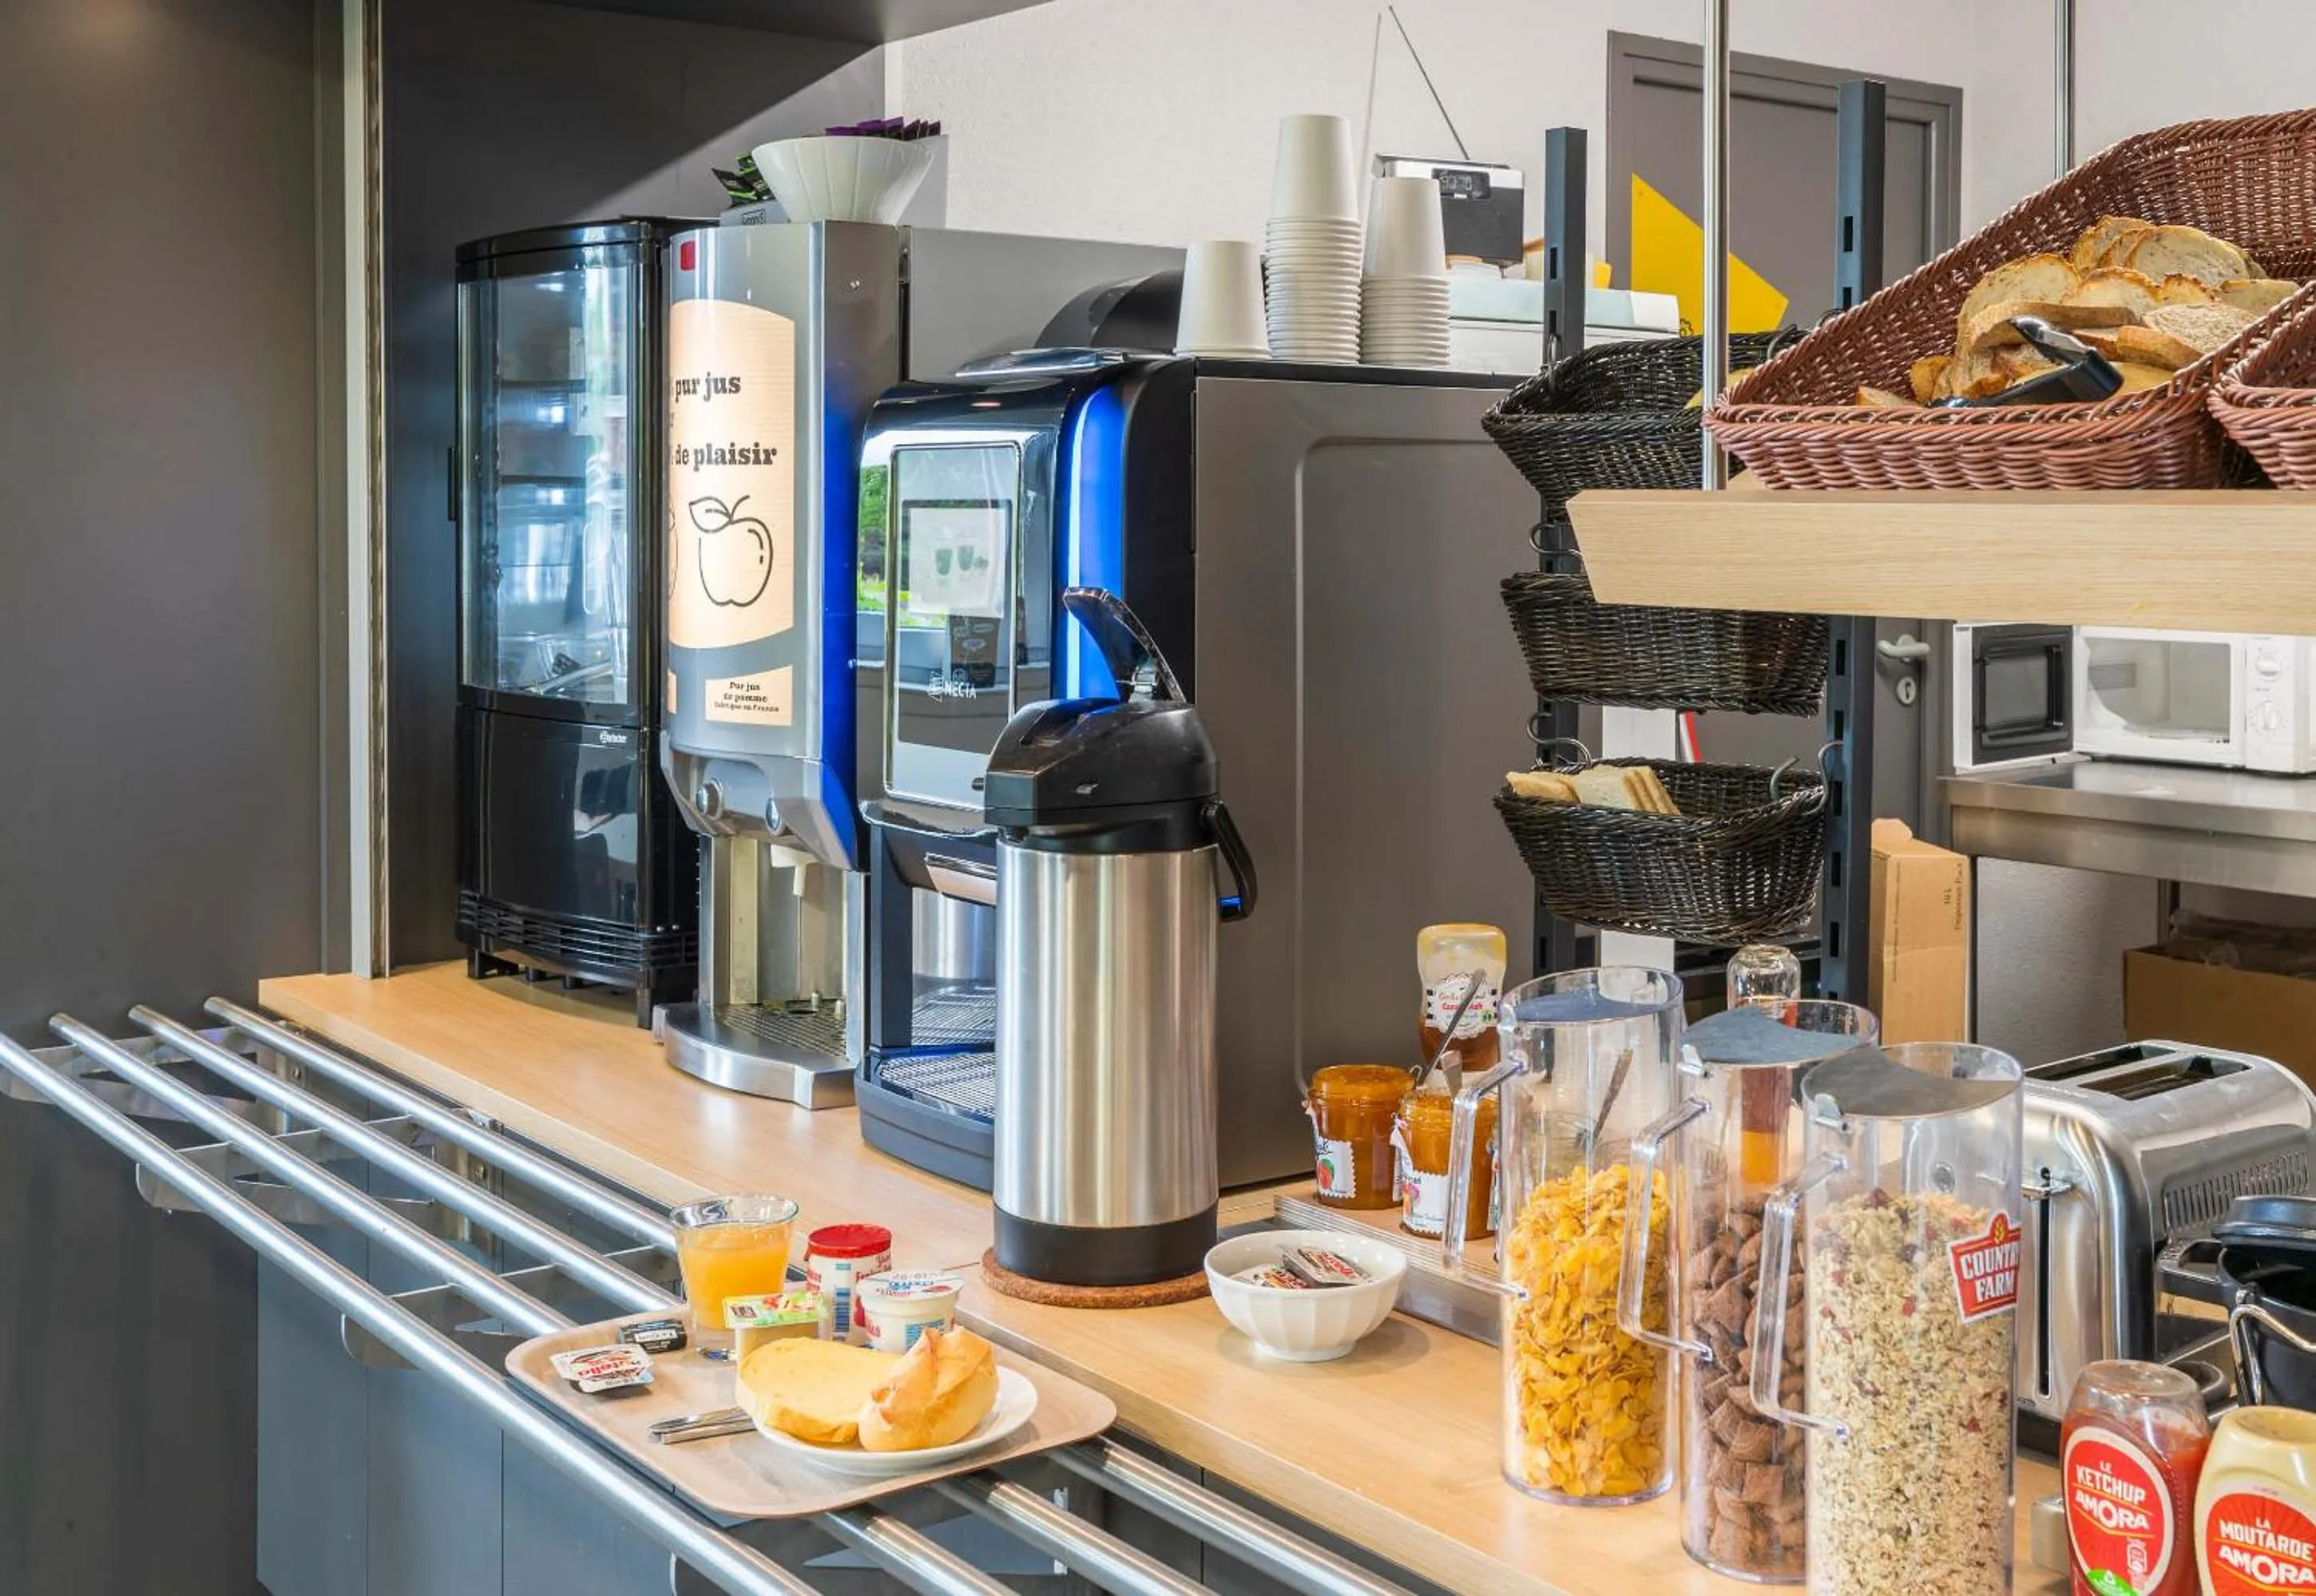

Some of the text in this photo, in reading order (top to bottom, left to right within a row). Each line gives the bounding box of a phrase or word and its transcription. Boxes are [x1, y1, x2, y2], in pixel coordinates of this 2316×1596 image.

[676, 371, 741, 403] pur jus
[676, 442, 777, 472] de plaisir
[1961, 1243, 2020, 1280] COUNTR
[1975, 1269, 2013, 1303] FARM
[2076, 1464, 2146, 1505] KETCHUP
[2100, 1460, 2112, 1475] LE
[2076, 1490, 2149, 1531] AMORA
[2255, 1516, 2271, 1529] LA
[2219, 1518, 2314, 1562] MOUTARDE
[2219, 1545, 2316, 1585] AMORA
